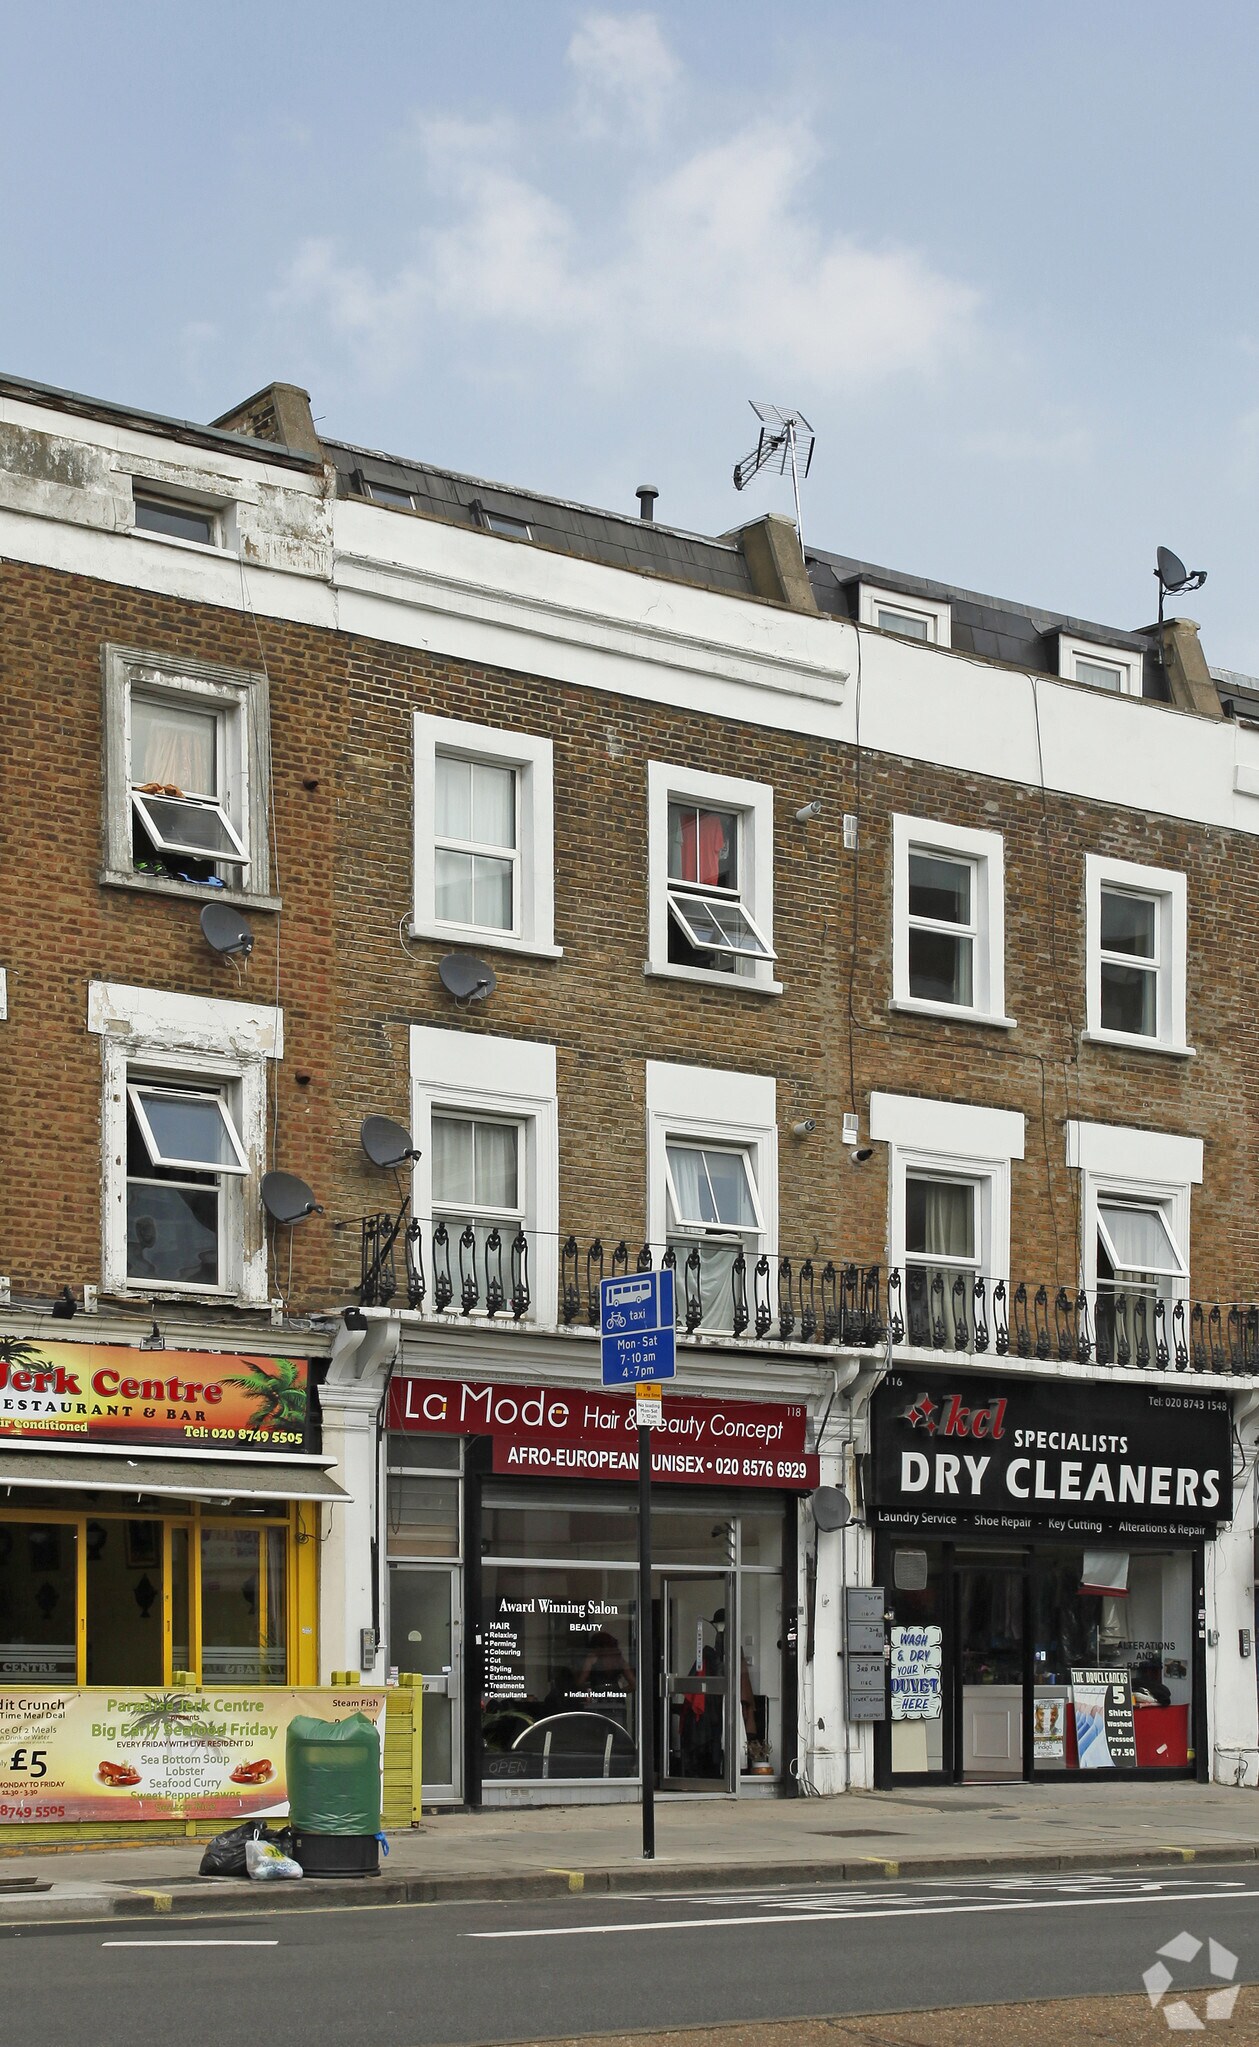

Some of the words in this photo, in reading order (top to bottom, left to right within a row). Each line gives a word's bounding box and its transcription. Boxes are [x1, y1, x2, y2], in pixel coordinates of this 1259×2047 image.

[630, 1309, 646, 1320] taxi
[92, 1368, 223, 1404] Centre
[886, 1377, 902, 1386] 116
[1149, 1396, 1164, 1406] Tel:
[1166, 1398, 1181, 1408] 020
[1183, 1398, 1204, 1409] 8743
[1207, 1400, 1227, 1411] 1548
[143, 1408, 156, 1418] &
[167, 1409, 206, 1421] BAR
[405, 1380, 447, 1420] La
[460, 1384, 570, 1428] Mode
[584, 1406, 620, 1429] Hair
[624, 1409, 638, 1430] &
[650, 1416, 705, 1441] eauty
[710, 1414, 783, 1445] Concept
[787, 1407, 801, 1417] 118
[943, 1394, 1007, 1439] kcl
[14, 1420, 88, 1432] Conditioned
[184, 1426, 208, 1438] Tel:
[211, 1428, 235, 1440] 020
[238, 1429, 268, 1443] 8749
[272, 1432, 303, 1444] 5505
[1014, 1430, 1128, 1454] SPECIALISTS
[508, 1446, 638, 1469] AFRO-EUROPEAN
[652, 1454, 704, 1473] UNISEX
[715, 1458, 738, 1475] 020
[743, 1460, 774, 1477] 8576
[777, 1462, 807, 1478] 6929
[901, 1452, 991, 1494] DRY
[1006, 1458, 1220, 1508] CLEANERS
[878, 1511, 919, 1525] Laundry
[922, 1513, 956, 1524] Service
[974, 1516, 999, 1526] Shoe
[1001, 1517, 1032, 1529] Repair
[1048, 1519, 1066, 1531] Key
[1067, 1519, 1102, 1532] Cutting
[1118, 1522, 1168, 1534] Alterations
[1169, 1524, 1176, 1534] &
[1178, 1524, 1206, 1536] Repair
[499, 1598, 535, 1613] Award
[538, 1599, 586, 1617] Winning
[588, 1600, 618, 1614] Salon
[900, 1633, 928, 1646] WASH
[1117, 1642, 1176, 1650] ALTERATIONS
[898, 1650, 904, 1662] &
[910, 1650, 930, 1662] DRY
[3, 1663, 56, 1672] CENTRE
[898, 1665, 918, 1675] YOUR
[890, 1678, 938, 1694] DUVET
[1112, 1686, 1125, 1704] 5
[18, 1699, 65, 1710] Crunch
[107, 1699, 173, 1712] Paradise
[178, 1698, 210, 1712] Jerk
[214, 1699, 264, 1712] Centre
[902, 1698, 929, 1710] HERE
[92, 1723, 116, 1740] Big
[121, 1722, 160, 1740] Early
[163, 1722, 226, 1736] Seafood
[231, 1722, 278, 1739] Friday
[10, 1749, 47, 1778] £5
[141, 1755, 159, 1764] Sea
[162, 1755, 200, 1764] Bottom
[203, 1754, 230, 1765] Soup
[166, 1766, 205, 1776] Lobster
[489, 1759, 527, 1774] OPEN
[150, 1778, 191, 1788] Seafood
[194, 1778, 221, 1789] Curry
[165, 1791, 200, 1801] Pepper
[203, 1790, 241, 1798] Prawns
[0, 1805, 32, 1818] 8749
[36, 1806, 65, 1817] 5505
